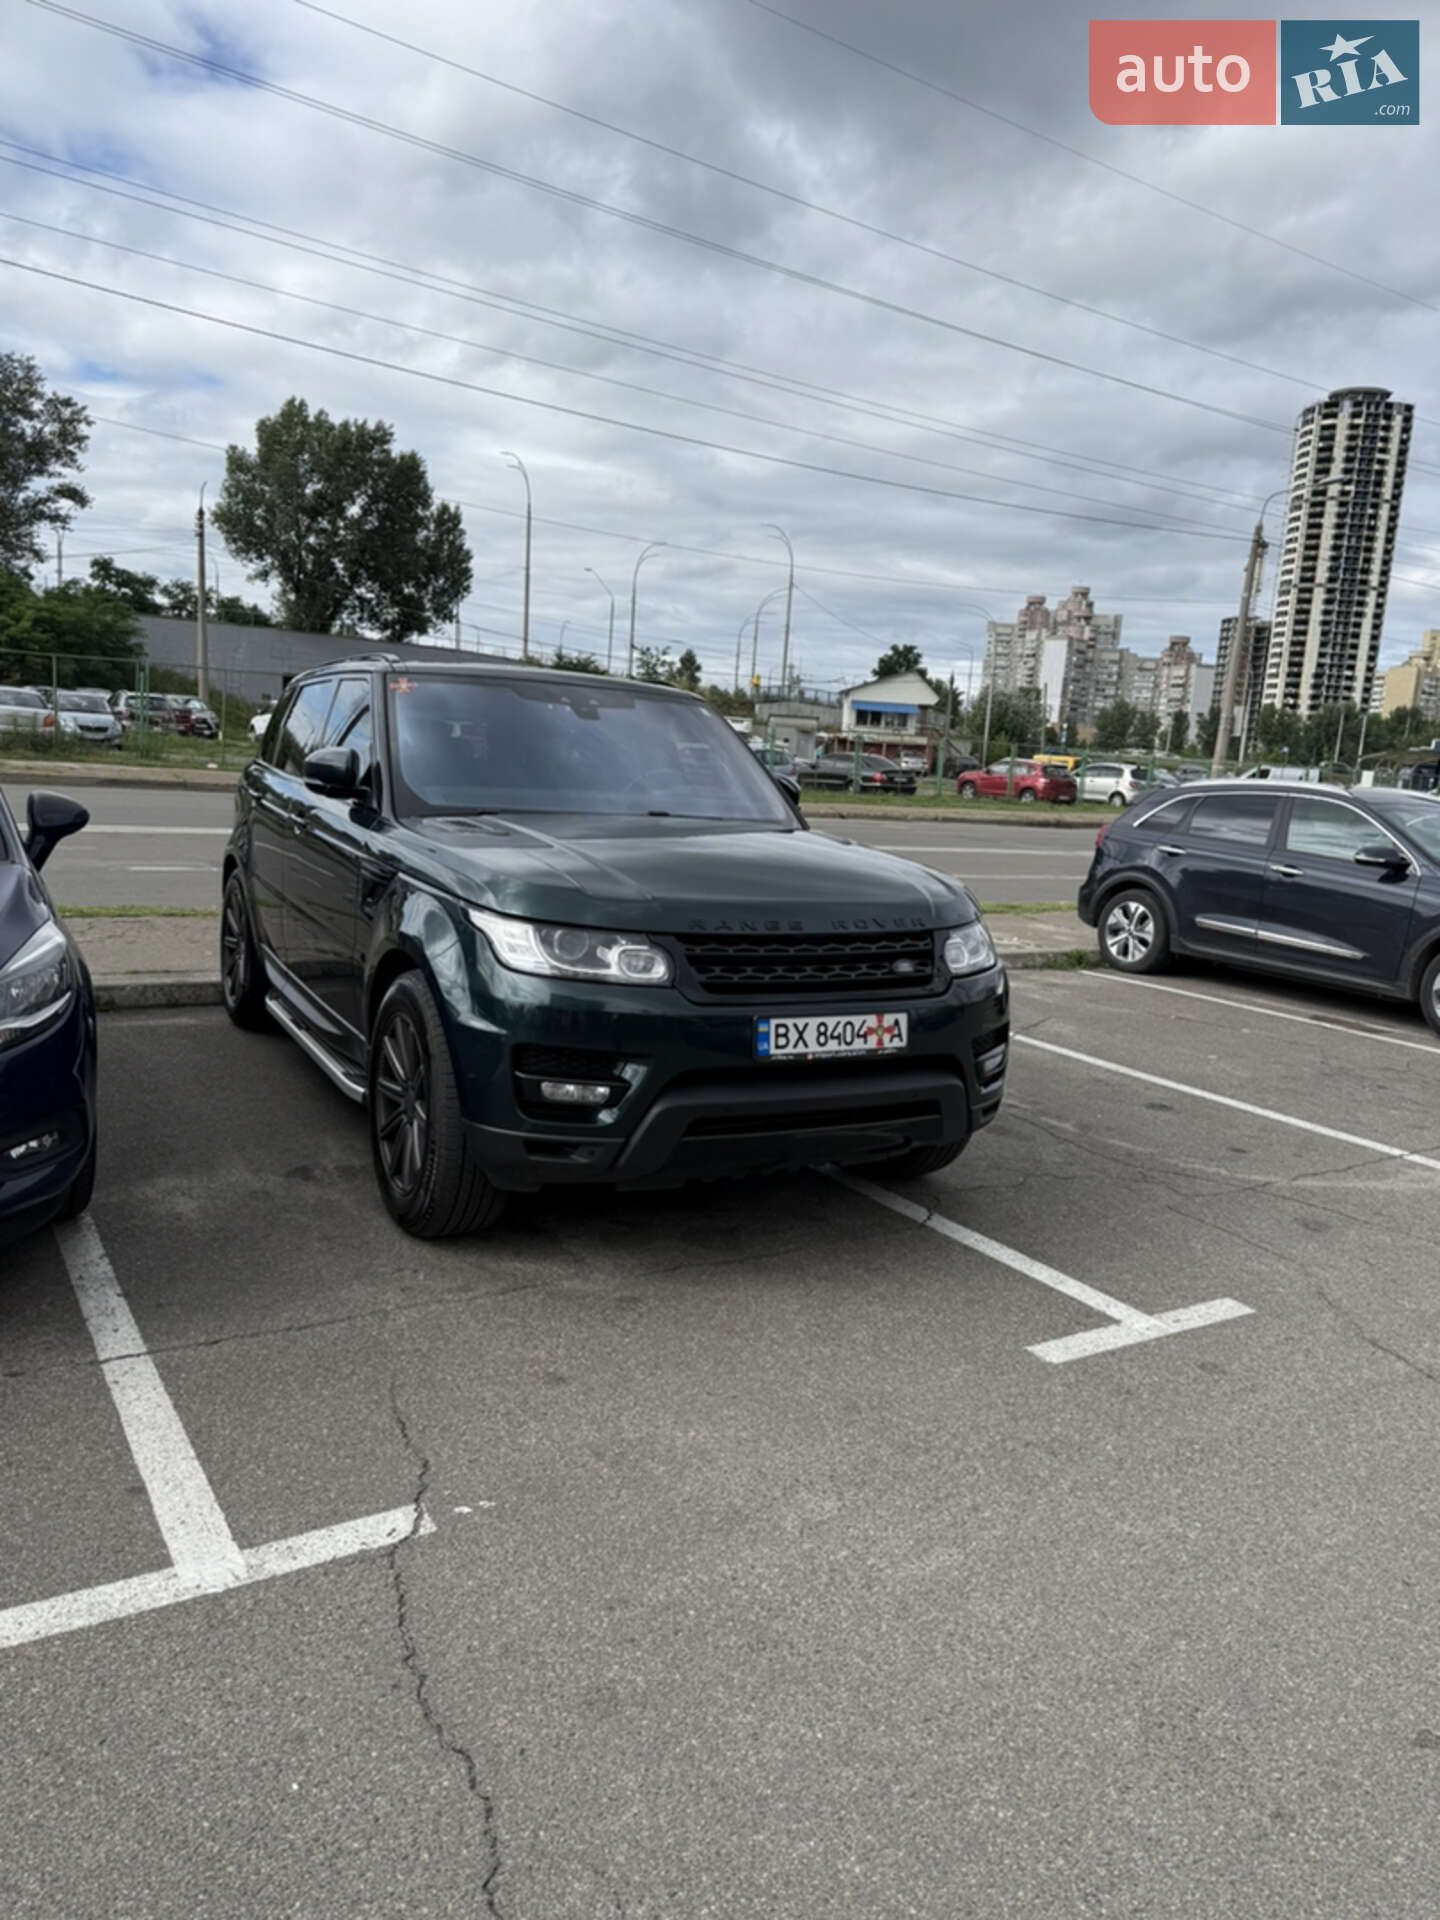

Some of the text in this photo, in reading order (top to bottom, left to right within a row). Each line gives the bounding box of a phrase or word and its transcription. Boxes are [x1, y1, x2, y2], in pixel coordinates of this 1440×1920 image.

[688, 916, 927, 932] RANGE ROVER
[774, 1022, 809, 1050] BX
[816, 1020, 868, 1048] 8404
